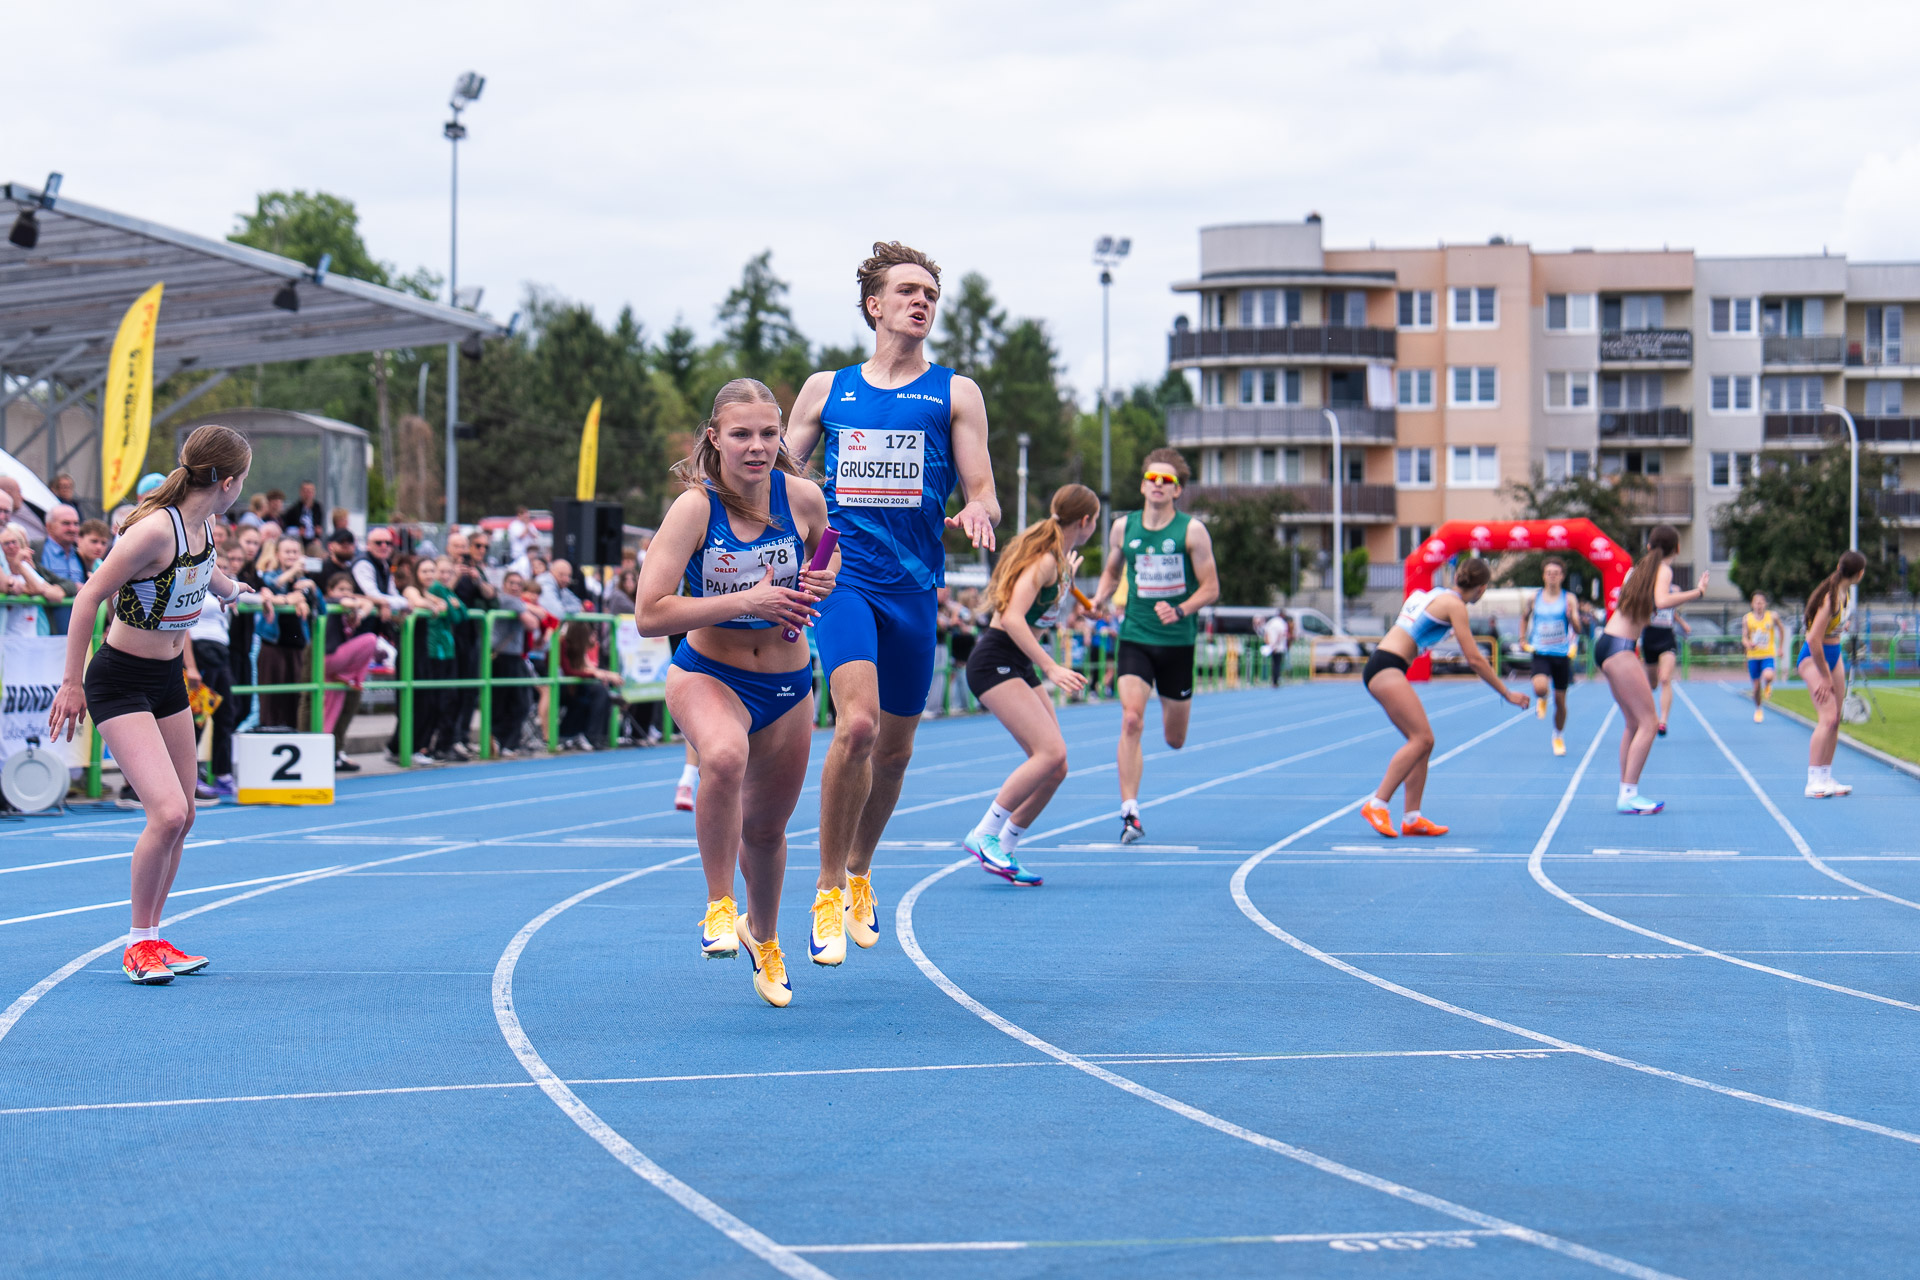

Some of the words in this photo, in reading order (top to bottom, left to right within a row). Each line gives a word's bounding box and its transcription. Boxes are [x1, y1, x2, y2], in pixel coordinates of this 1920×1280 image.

[896, 392, 921, 400] MLUKS
[923, 394, 944, 405] RAWA
[885, 434, 917, 450] 172
[840, 461, 920, 479] GRUSZFELD
[846, 496, 890, 504] PIASECZNO
[891, 497, 910, 505] 2026
[757, 549, 789, 568] 178
[271, 743, 302, 782] 2
